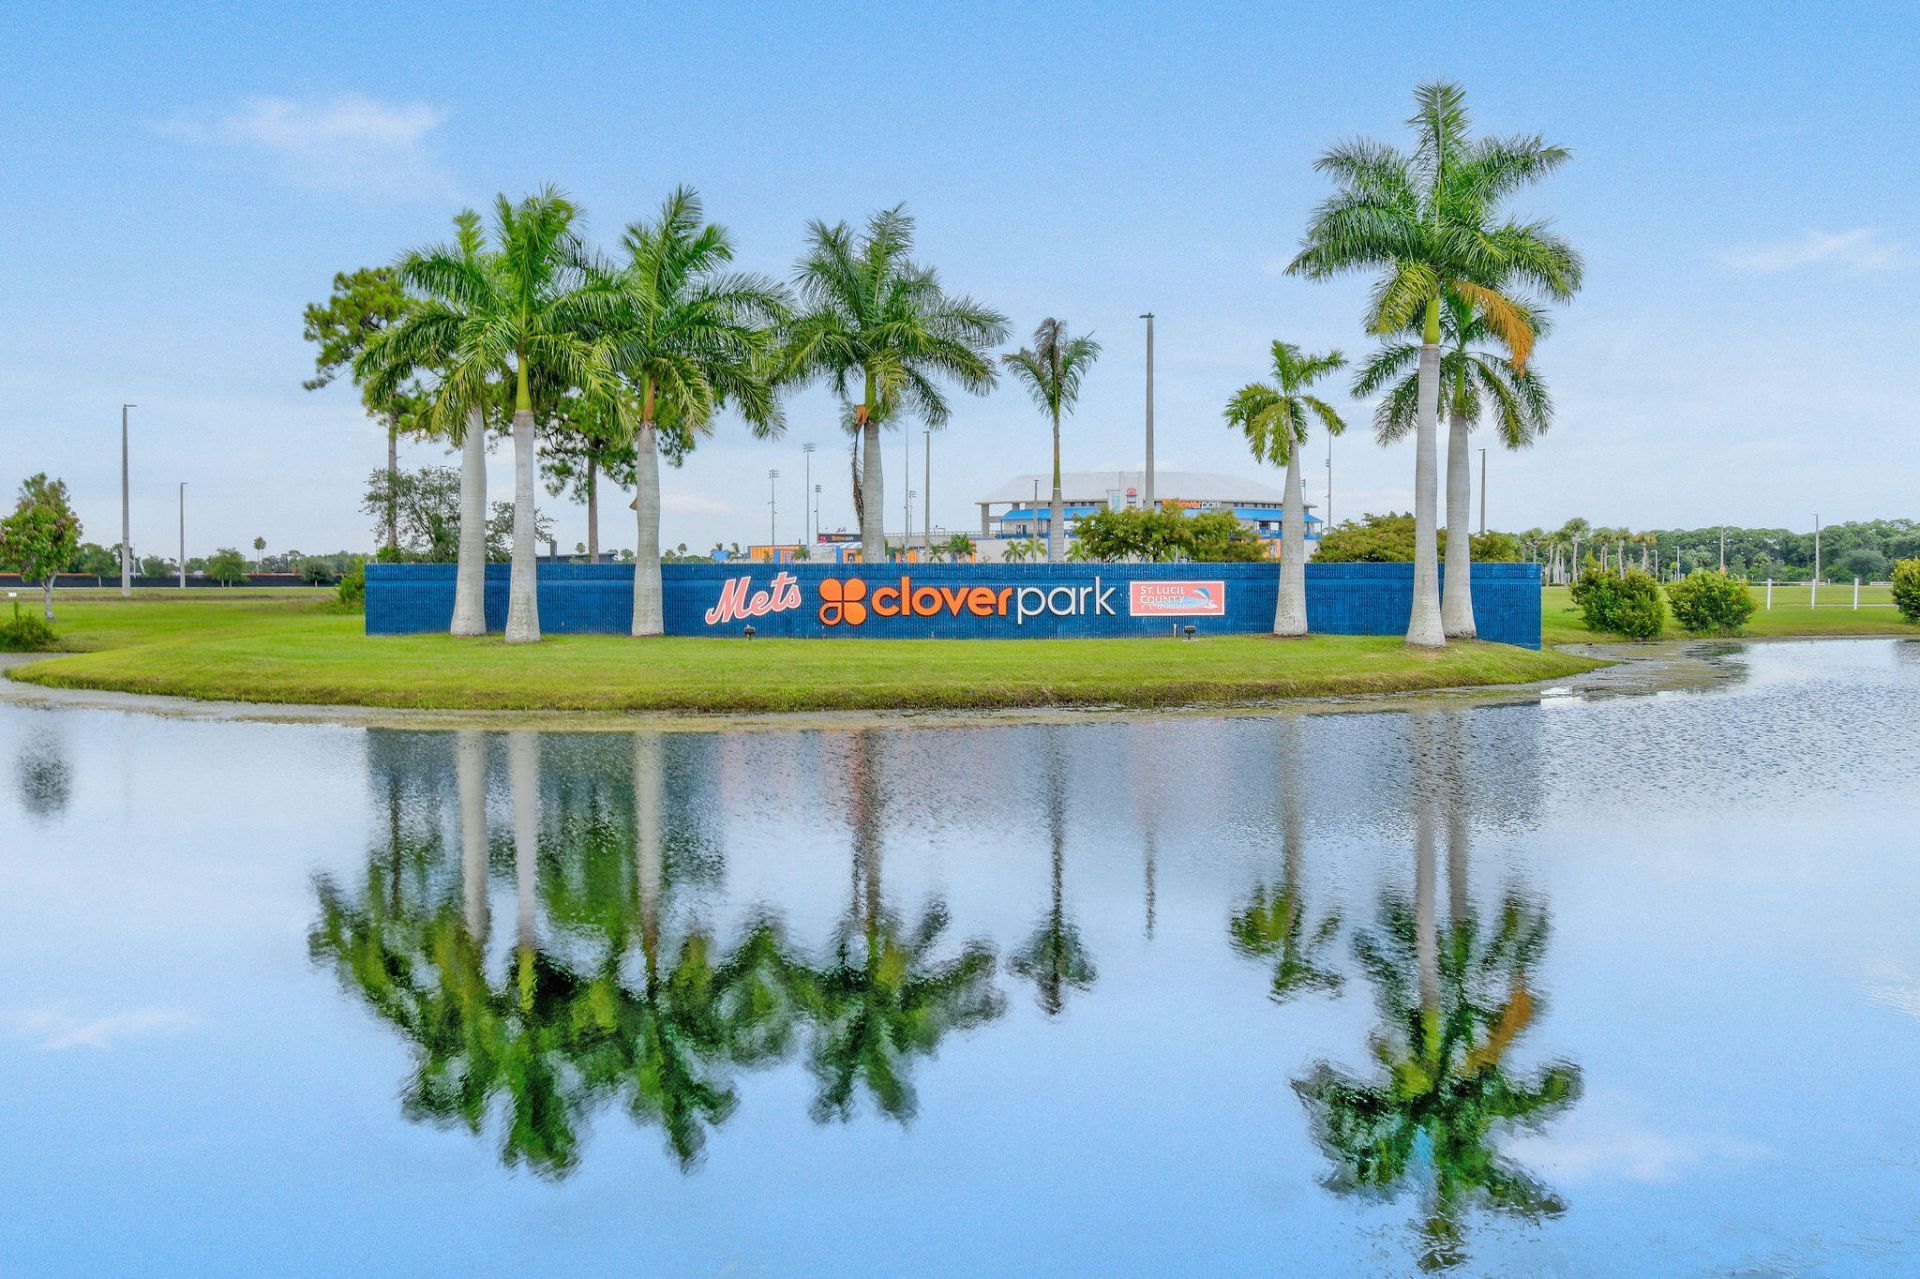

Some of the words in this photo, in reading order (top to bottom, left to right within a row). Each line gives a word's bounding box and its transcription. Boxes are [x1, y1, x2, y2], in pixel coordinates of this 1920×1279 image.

[1157, 586, 1184, 595] LUCIE
[705, 571, 802, 625] Mets
[1140, 596, 1184, 604] COUNTY
